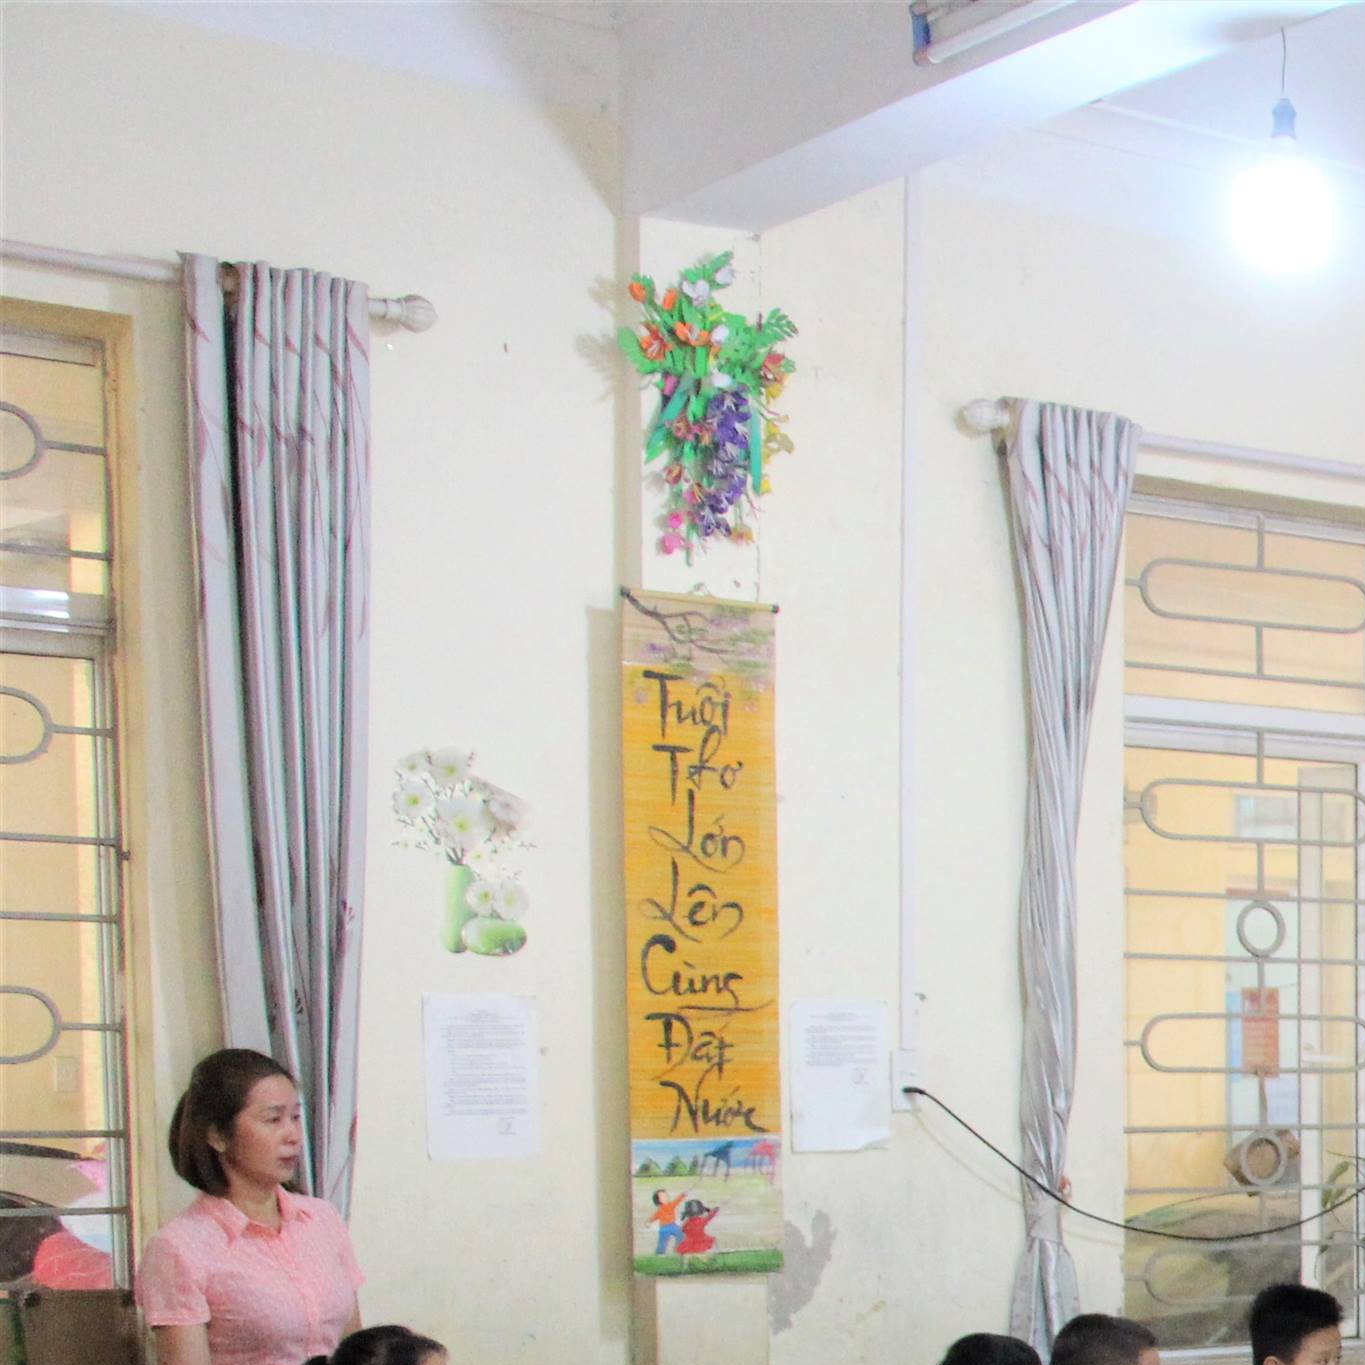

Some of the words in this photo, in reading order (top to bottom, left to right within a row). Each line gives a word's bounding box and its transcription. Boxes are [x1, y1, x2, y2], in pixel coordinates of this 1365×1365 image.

[642, 669, 733, 738] Tuổi
[652, 725, 744, 806] Thơ
[649, 788, 746, 874] Lớn
[638, 856, 744, 943] Lên
[642, 934, 776, 1012] Cùng
[644, 1012, 735, 1080] Đất
[660, 1063, 770, 1134] Nước
